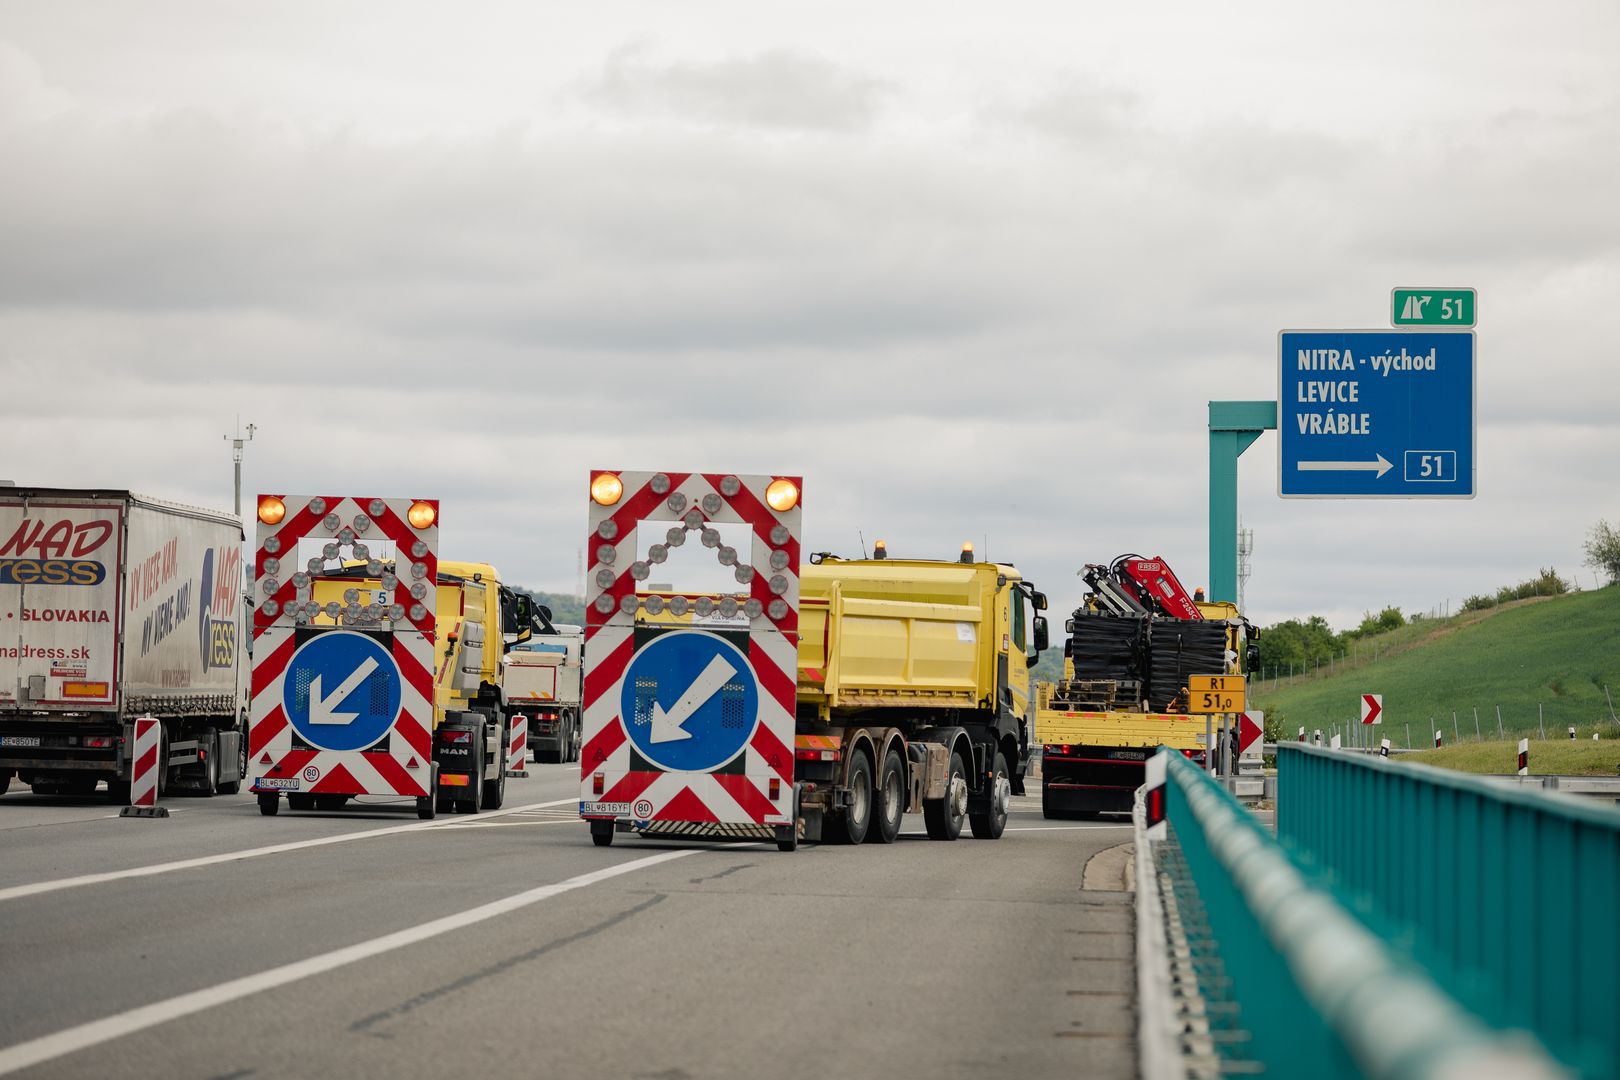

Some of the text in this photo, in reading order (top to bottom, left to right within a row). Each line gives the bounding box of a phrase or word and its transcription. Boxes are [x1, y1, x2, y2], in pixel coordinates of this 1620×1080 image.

[1441, 298, 1463, 320] 51
[1297, 349, 1355, 371] NITRA
[1370, 347, 1436, 377] východ
[1297, 381, 1359, 403] LEVICE
[1296, 408, 1370, 435] VRÁBLE
[1420, 455, 1442, 477] 51
[0, 518, 114, 560] NAD
[378, 592, 387, 604] 5
[22, 608, 111, 623] SLOVAKIA
[210, 622, 235, 666] ress
[1210, 677, 1225, 690] R1
[1203, 693, 1232, 711] 51,0
[439, 748, 468, 756] MAN
[306, 768, 317, 777] 80
[637, 803, 649, 811] 80
